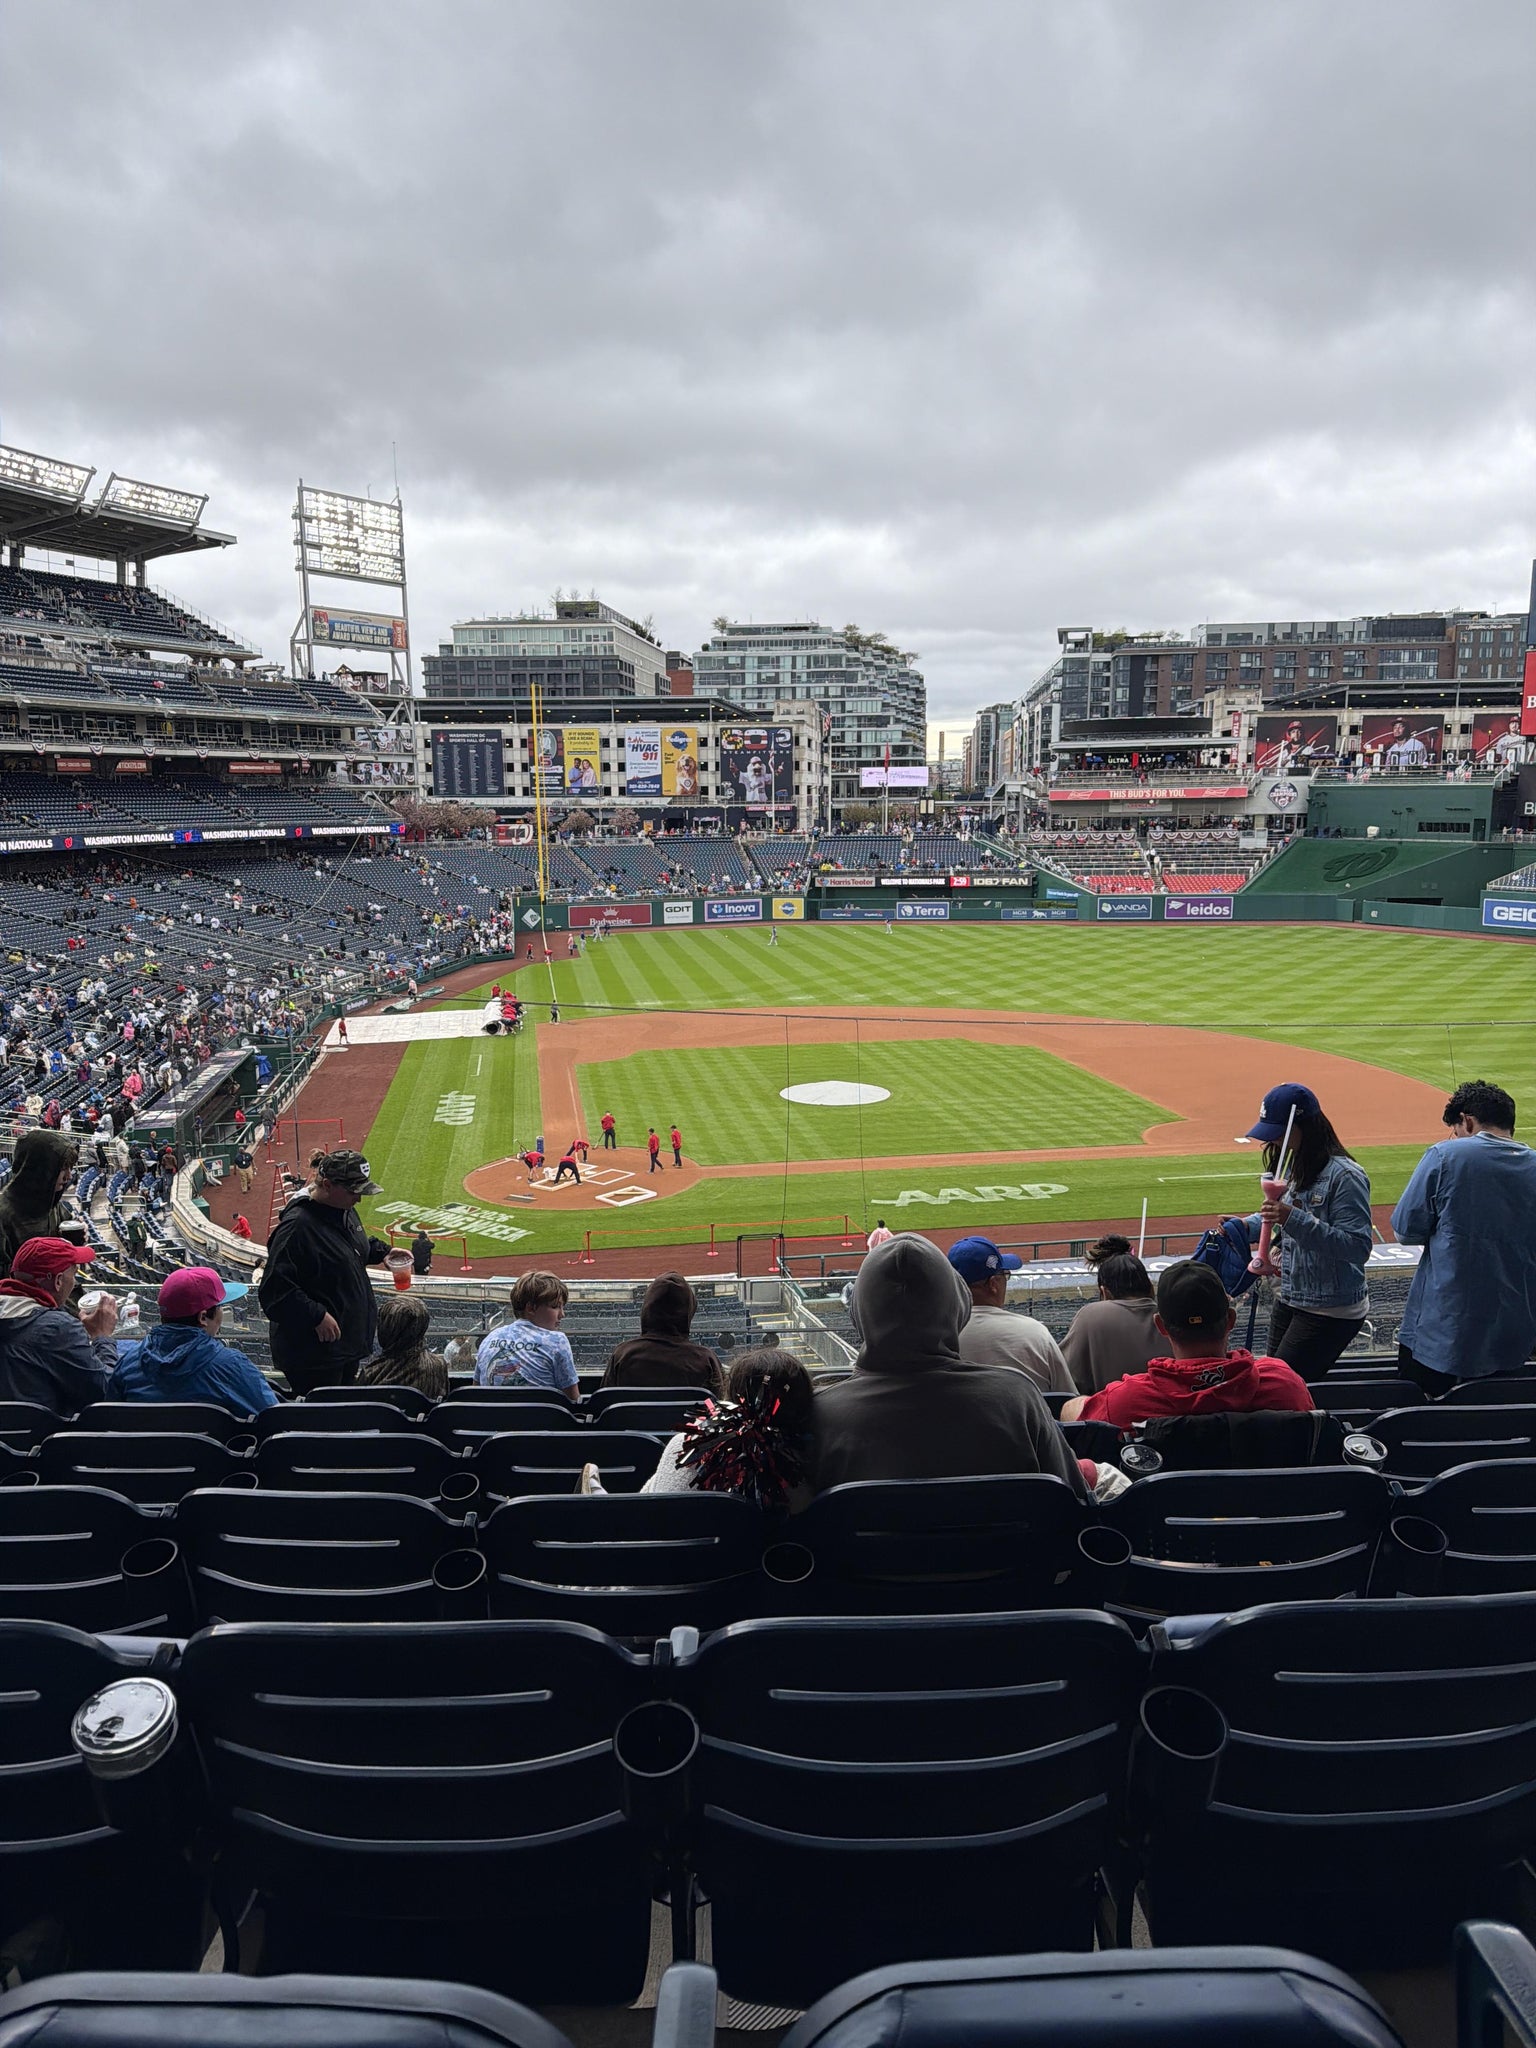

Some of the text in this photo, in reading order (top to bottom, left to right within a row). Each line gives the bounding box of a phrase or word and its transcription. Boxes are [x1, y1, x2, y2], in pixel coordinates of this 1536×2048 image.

[334, 622, 360, 633] BEAUTIFUL
[361, 625, 377, 635] VIEWS
[378, 627, 388, 636] AND
[332, 631, 351, 641] AWARD
[351, 633, 373, 643] WINNING
[374, 636, 391, 645] BREWS
[631, 744, 659, 752] HVAC
[642, 752, 658, 761] 911
[1109, 788, 1186, 798] THIS BUD'S FOR YOU.
[202, 828, 286, 839] WASHINGTON NATIONALS
[312, 825, 390, 835] WASHINGTON NATIONALS
[8, 840, 53, 850] NATIONALS
[84, 833, 174, 846] WASHINGTON NATIONALS
[725, 904, 755, 913] Inova
[914, 906, 945, 916] Terra
[1187, 902, 1230, 916] leidos
[589, 918, 632, 926] Budweiser
[433, 1090, 476, 1126] AARP
[871, 1184, 1069, 1207] AARP
[375, 1201, 535, 1242] OPENING WEEK
[489, 1340, 541, 1352] BIG ROCK
